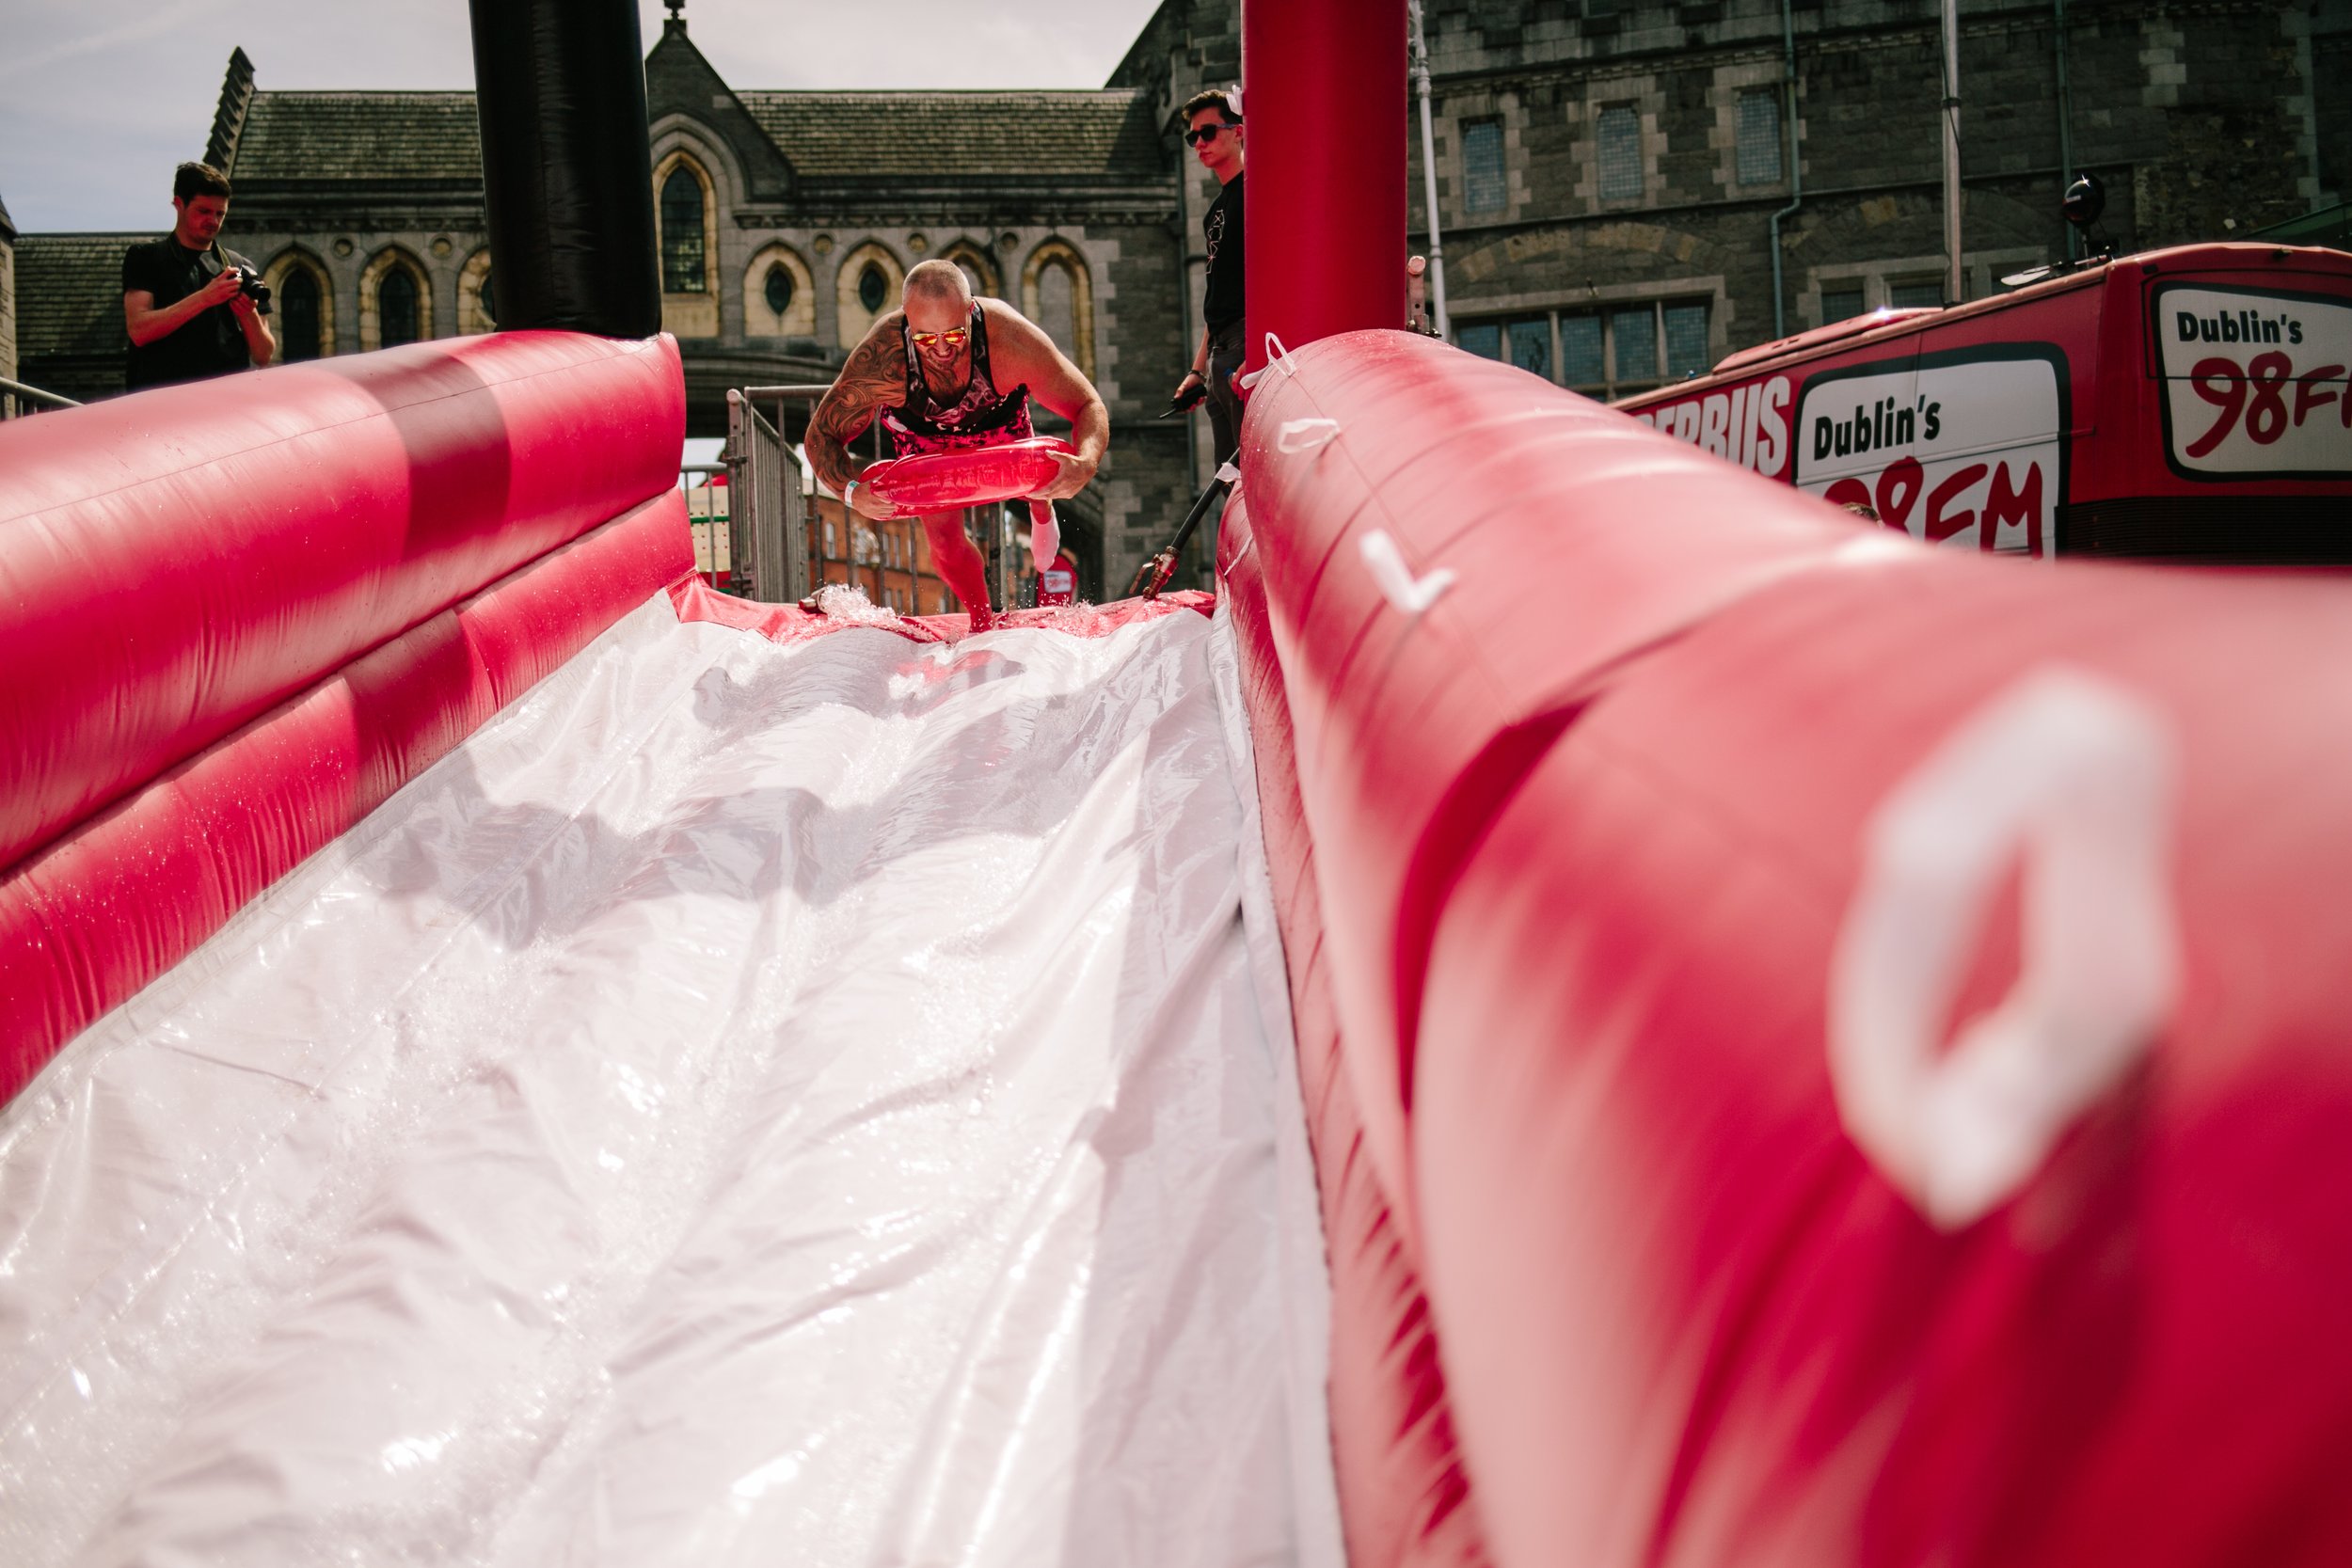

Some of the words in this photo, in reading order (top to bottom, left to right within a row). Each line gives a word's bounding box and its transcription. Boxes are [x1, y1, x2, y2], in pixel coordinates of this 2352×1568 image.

[2176, 309, 2303, 344] Dublin's
[1635, 375, 1790, 477] RBUS
[1814, 393, 1941, 461] Dublin's
[2185, 350, 2352, 458] 98F
